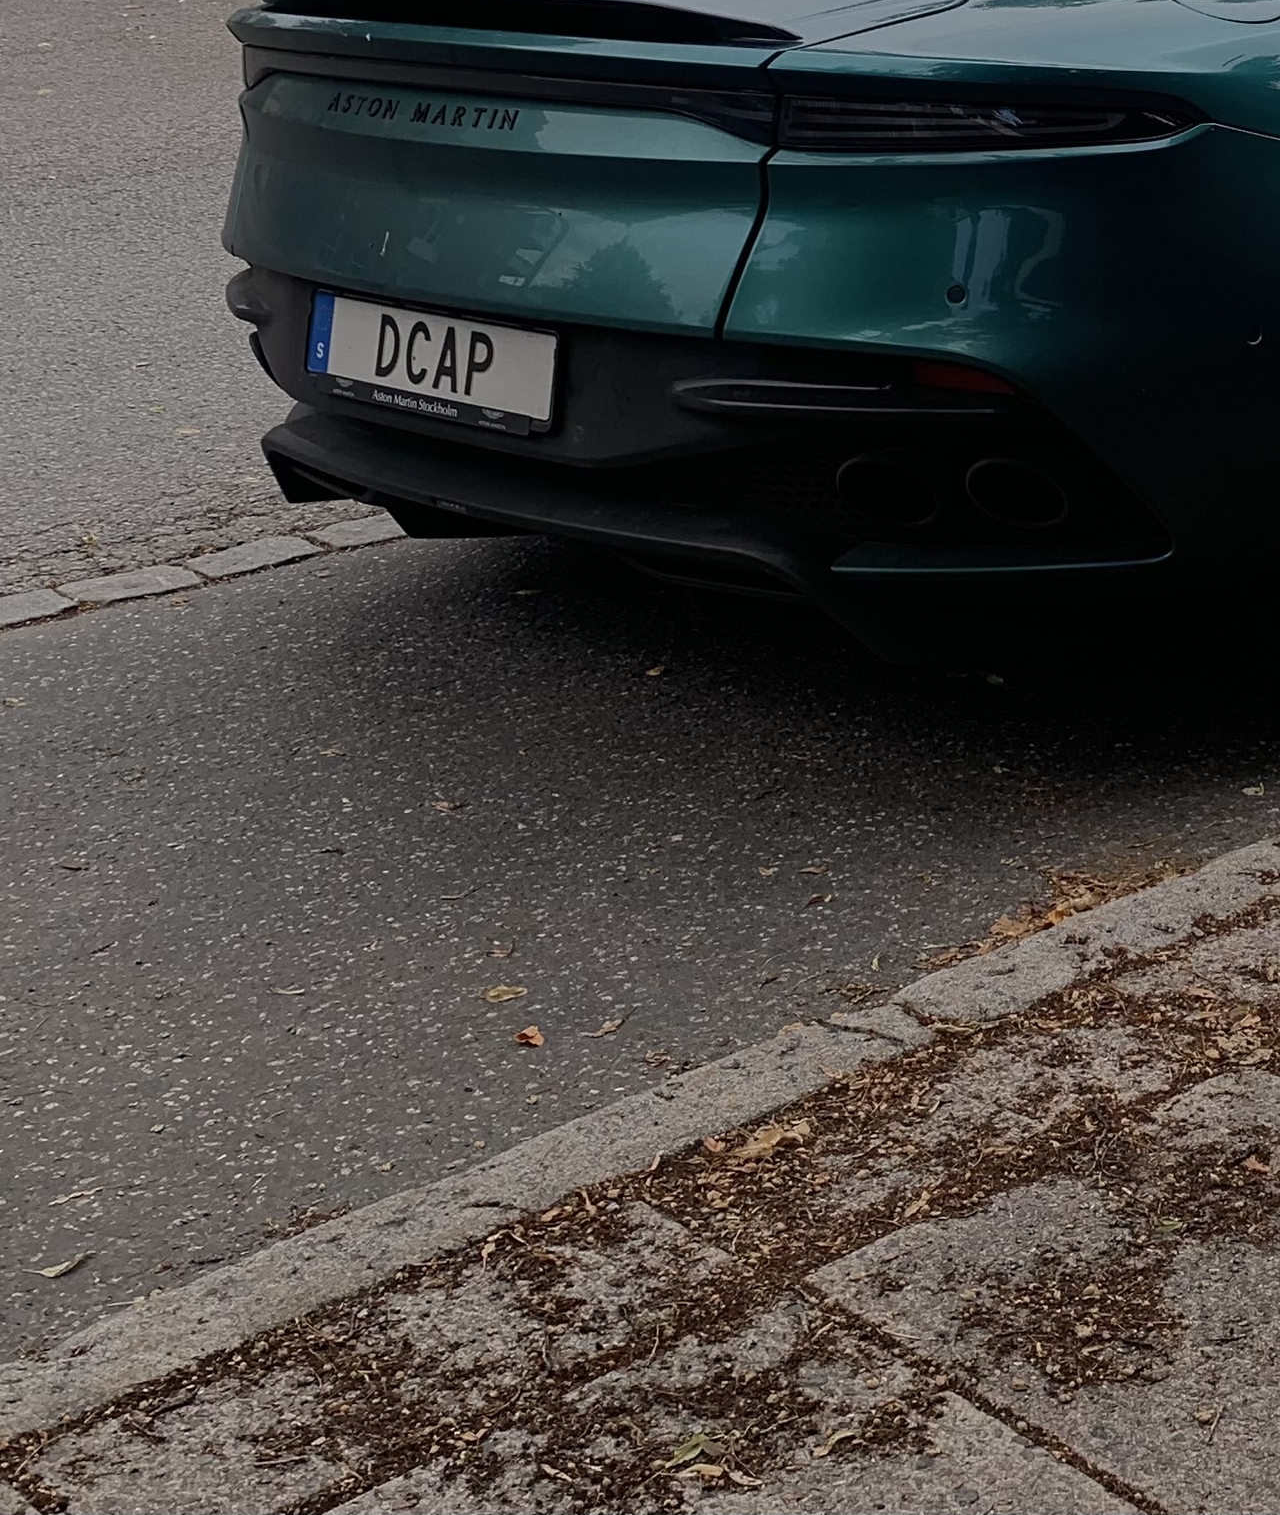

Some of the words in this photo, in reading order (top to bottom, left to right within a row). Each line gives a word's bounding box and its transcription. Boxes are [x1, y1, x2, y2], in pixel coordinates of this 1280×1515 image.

[327, 91, 401, 120] ASTON
[410, 101, 520, 131] MARTIN
[315, 341, 325, 359] S
[375, 313, 494, 396] DCAP
[371, 389, 393, 404] Aston
[393, 394, 418, 409] Martin
[418, 399, 458, 418] Stockholm
